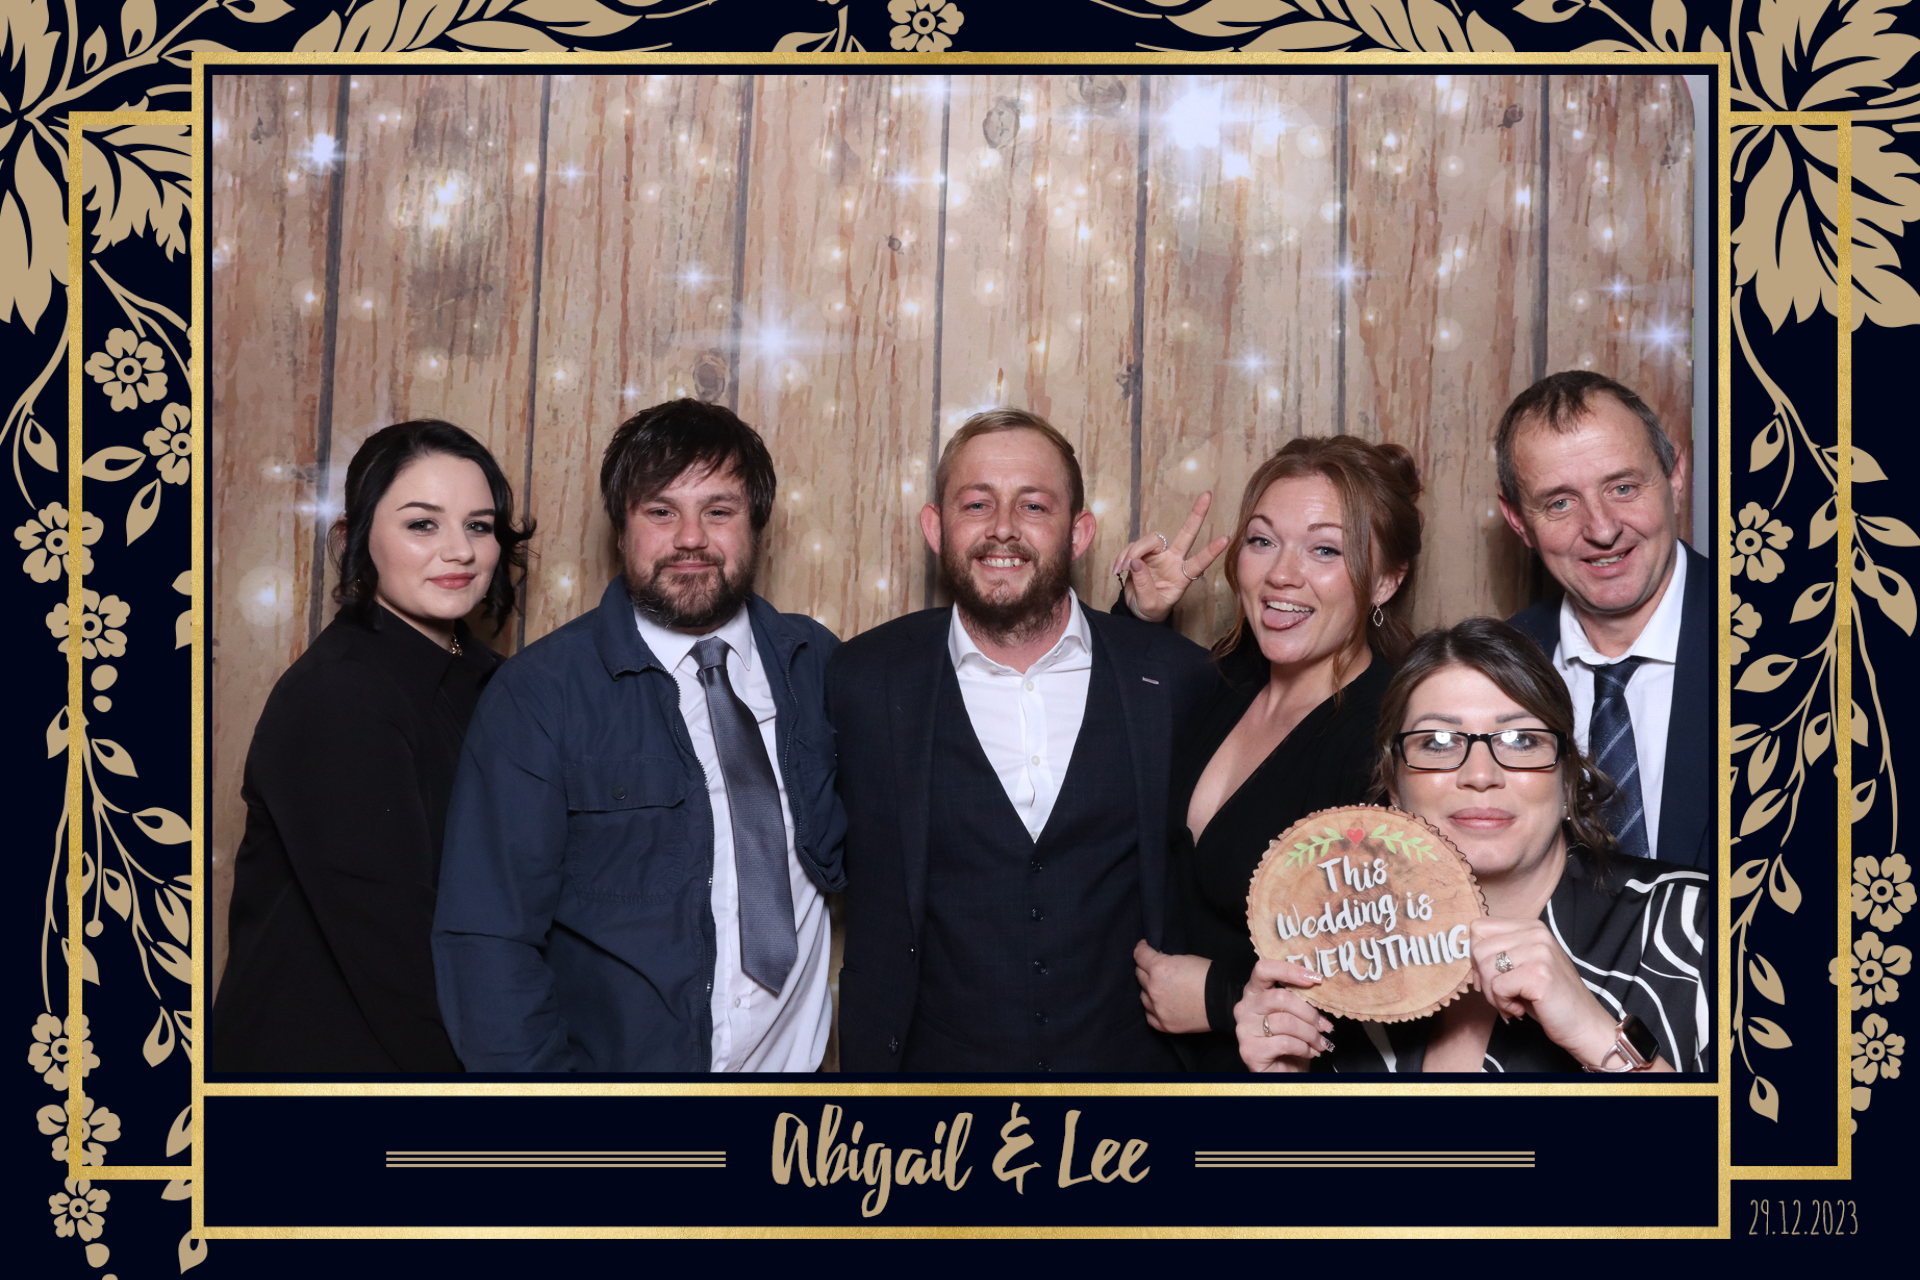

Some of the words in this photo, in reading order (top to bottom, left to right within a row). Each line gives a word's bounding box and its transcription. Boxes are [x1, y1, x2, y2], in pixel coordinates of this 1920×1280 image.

[1317, 855, 1389, 892] This
[1277, 893, 1399, 940] Wedding
[1406, 891, 1434, 921] is
